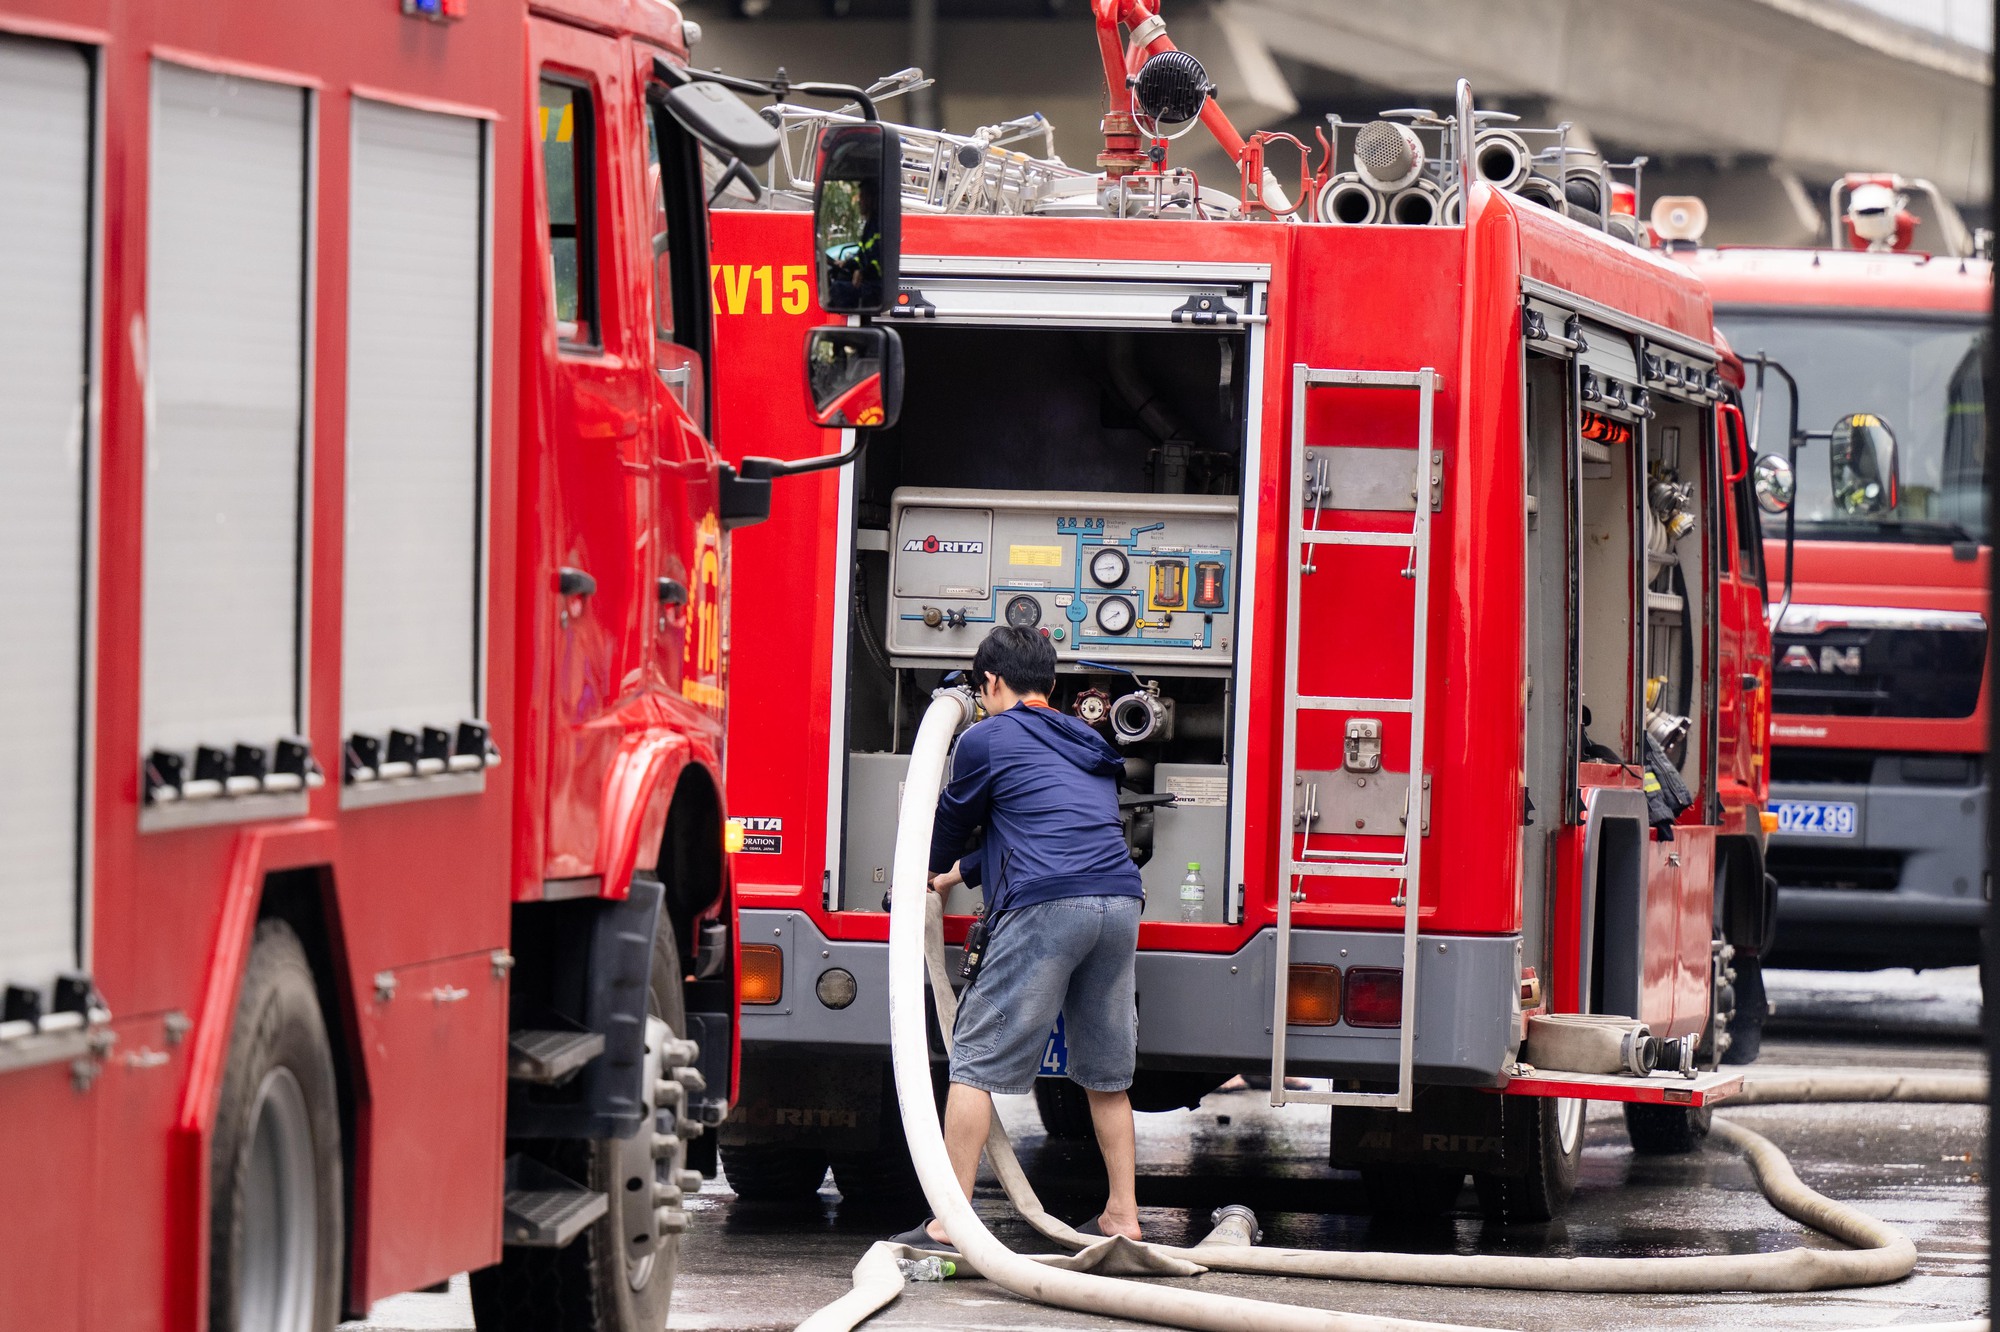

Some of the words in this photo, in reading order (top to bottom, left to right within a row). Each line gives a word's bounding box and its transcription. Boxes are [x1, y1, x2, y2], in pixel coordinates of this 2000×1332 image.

[903, 535, 983, 553] MORITA
[1775, 645, 1861, 674] AN
[730, 817, 782, 831] RITA
[743, 837, 775, 846] ORATION
[1356, 1130, 1503, 1153] MRITA
